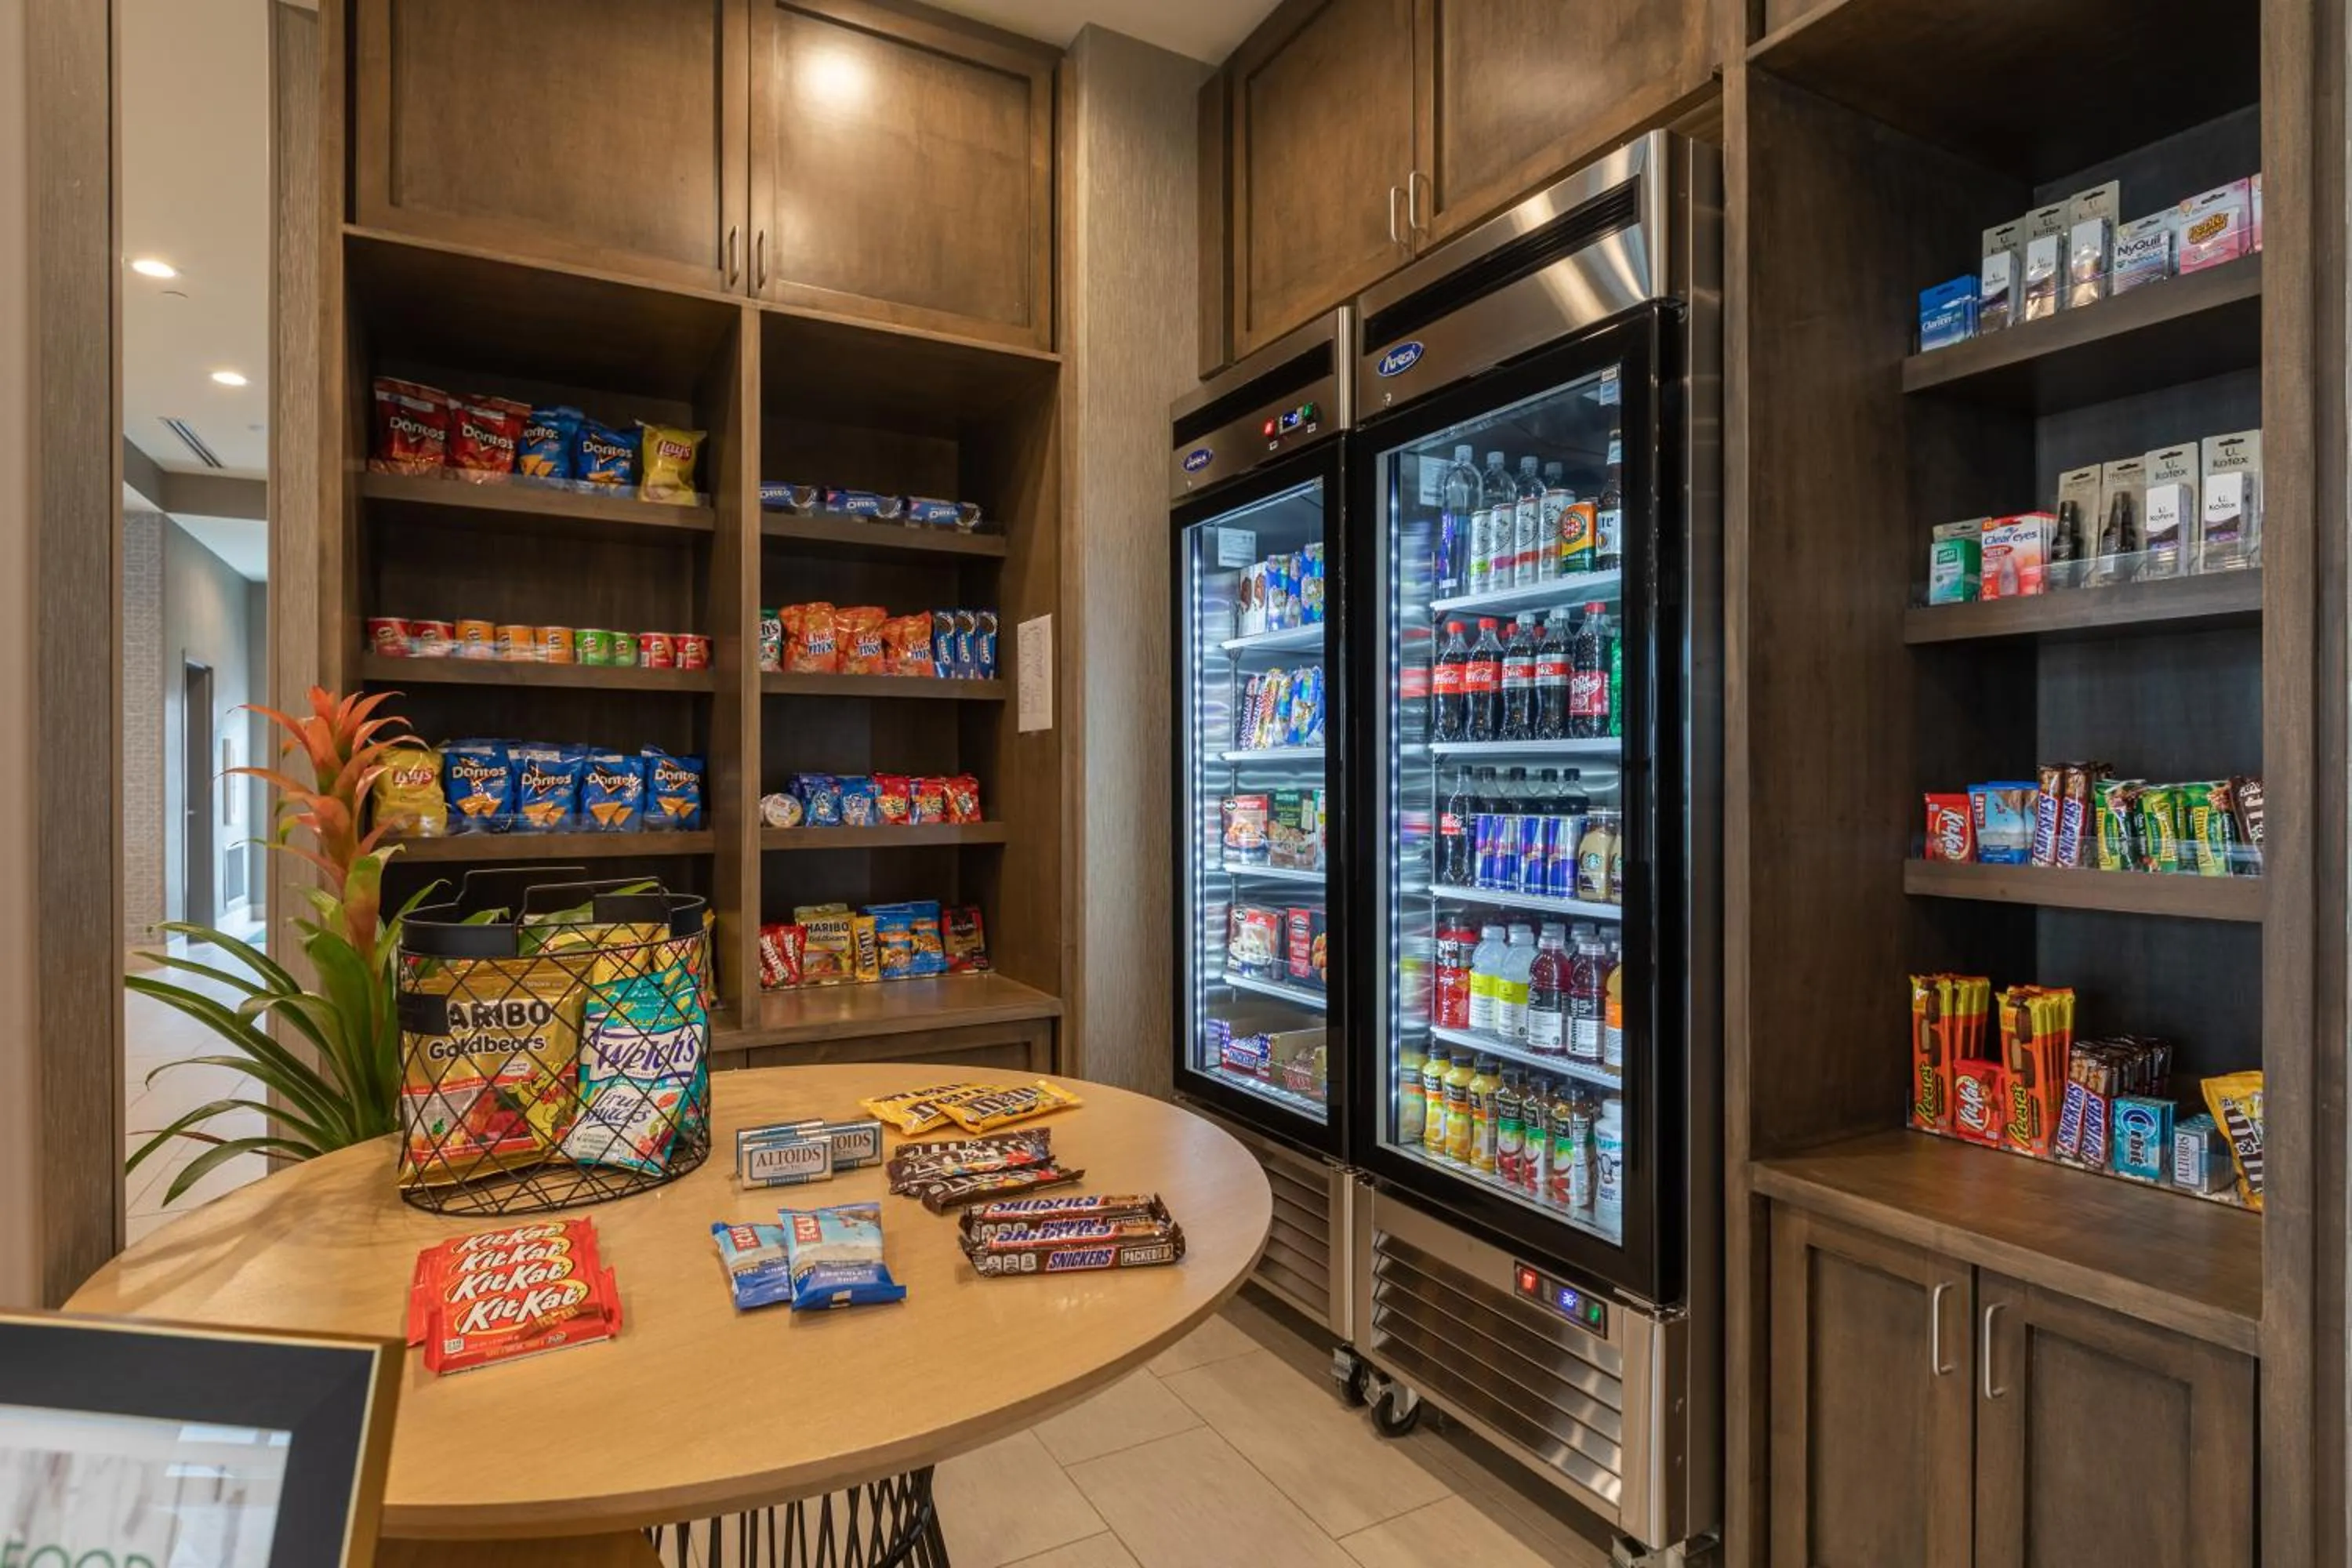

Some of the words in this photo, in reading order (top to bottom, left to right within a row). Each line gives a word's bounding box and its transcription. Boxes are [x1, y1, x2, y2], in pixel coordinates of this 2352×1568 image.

[2118, 234, 2161, 259] NyQuil
[390, 416, 445, 443] Doritos
[462, 423, 514, 452] Doritos
[583, 440, 633, 463] Doritos
[659, 440, 692, 461] Lay's
[1984, 531, 2010, 546] Clear
[2013, 529, 2038, 543] eyes
[453, 766, 507, 786] Doritos
[521, 771, 572, 790] Doritos
[589, 773, 639, 788] Doritos
[655, 768, 700, 785] Doritos
[2058, 803, 2082, 866] SNICKERS
[805, 921, 849, 934] HARIBO
[446, 1000, 552, 1031] ARIBO
[429, 1034, 546, 1060] Goldbears
[597, 1032, 695, 1073] Welch's
[2058, 1083, 2084, 1149] SNICKERS
[831, 1133, 872, 1150] TOIDS
[755, 1146, 822, 1168] ALTOIDS
[2177, 1136, 2190, 1180] ALTOIDS
[1047, 1249, 1113, 1269] SNICKERS
[1123, 1249, 1157, 1264] PACKED
